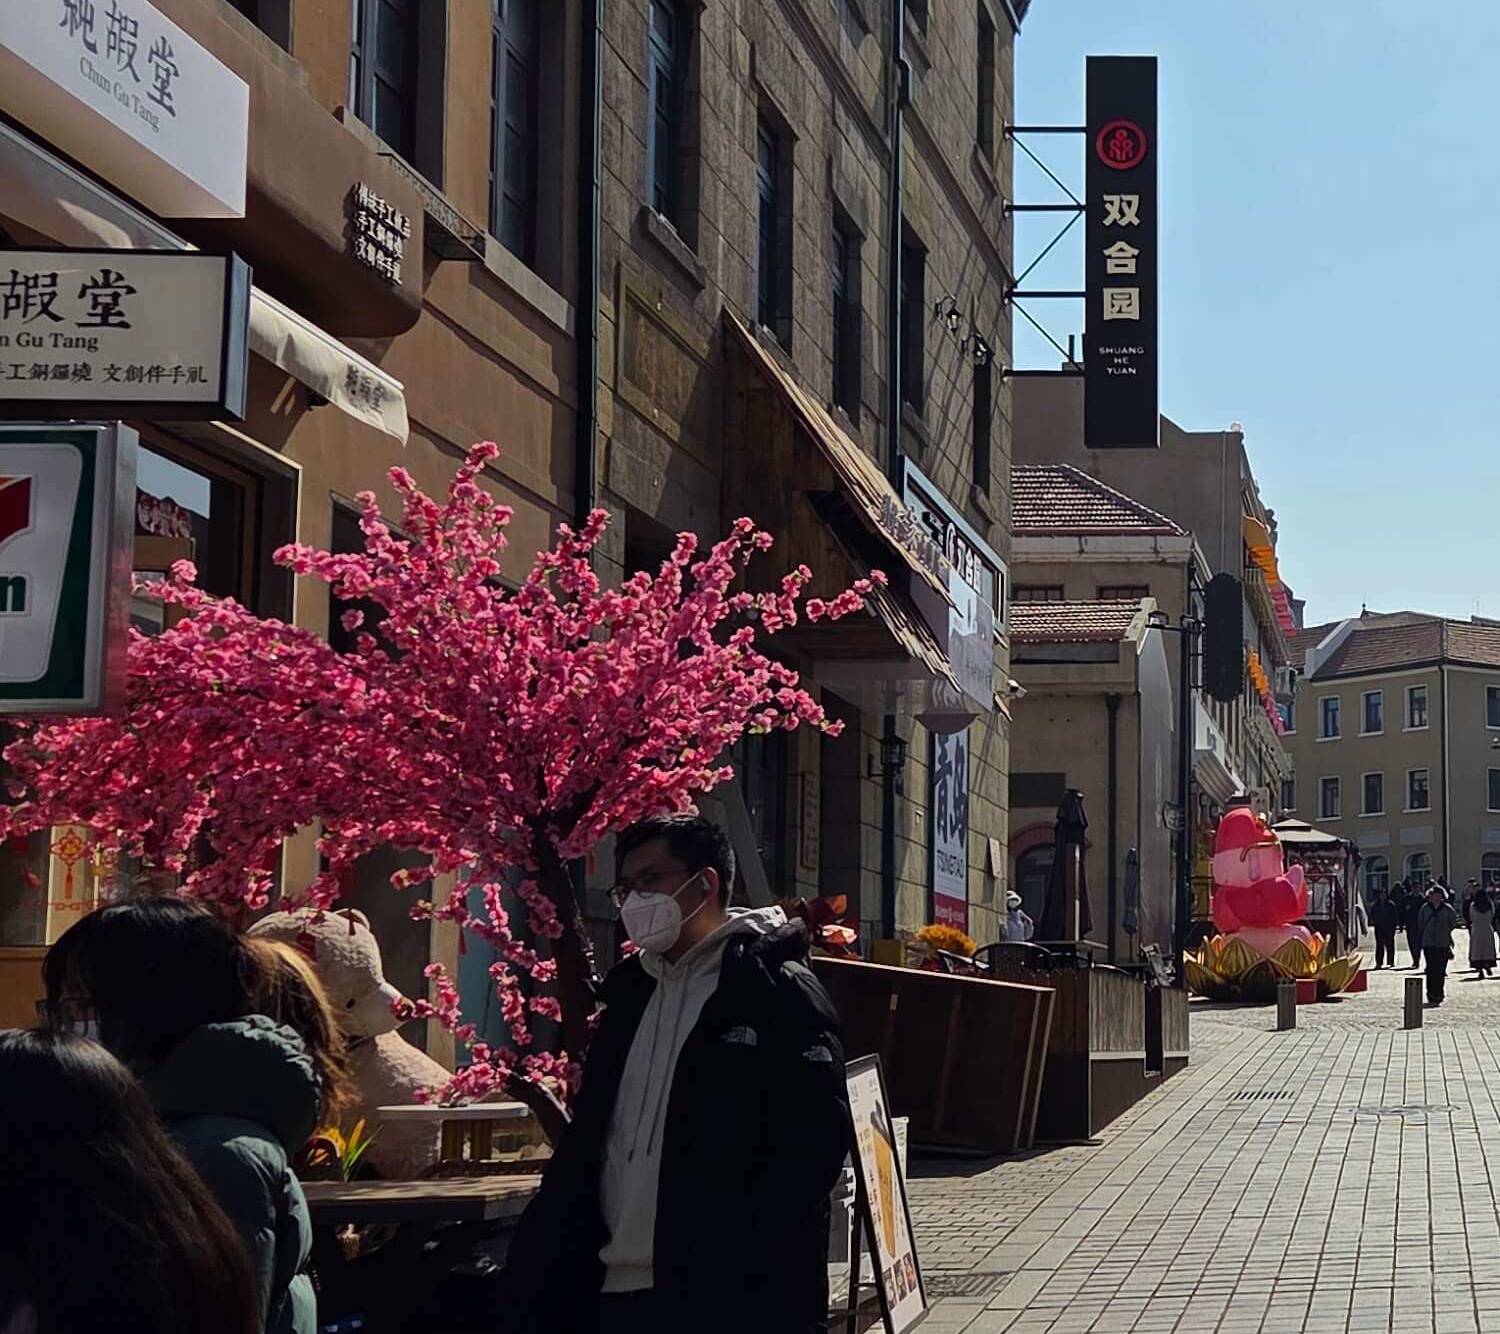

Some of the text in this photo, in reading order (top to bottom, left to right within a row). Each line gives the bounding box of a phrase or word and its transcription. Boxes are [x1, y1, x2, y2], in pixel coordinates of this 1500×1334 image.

[79, 57, 160, 132] Chun Gu Tang
[1102, 194, 1141, 321] 双合园
[16, 332, 43, 348] Gu
[48, 333, 99, 351] Tang
[1106, 367, 1136, 375] YUAN
